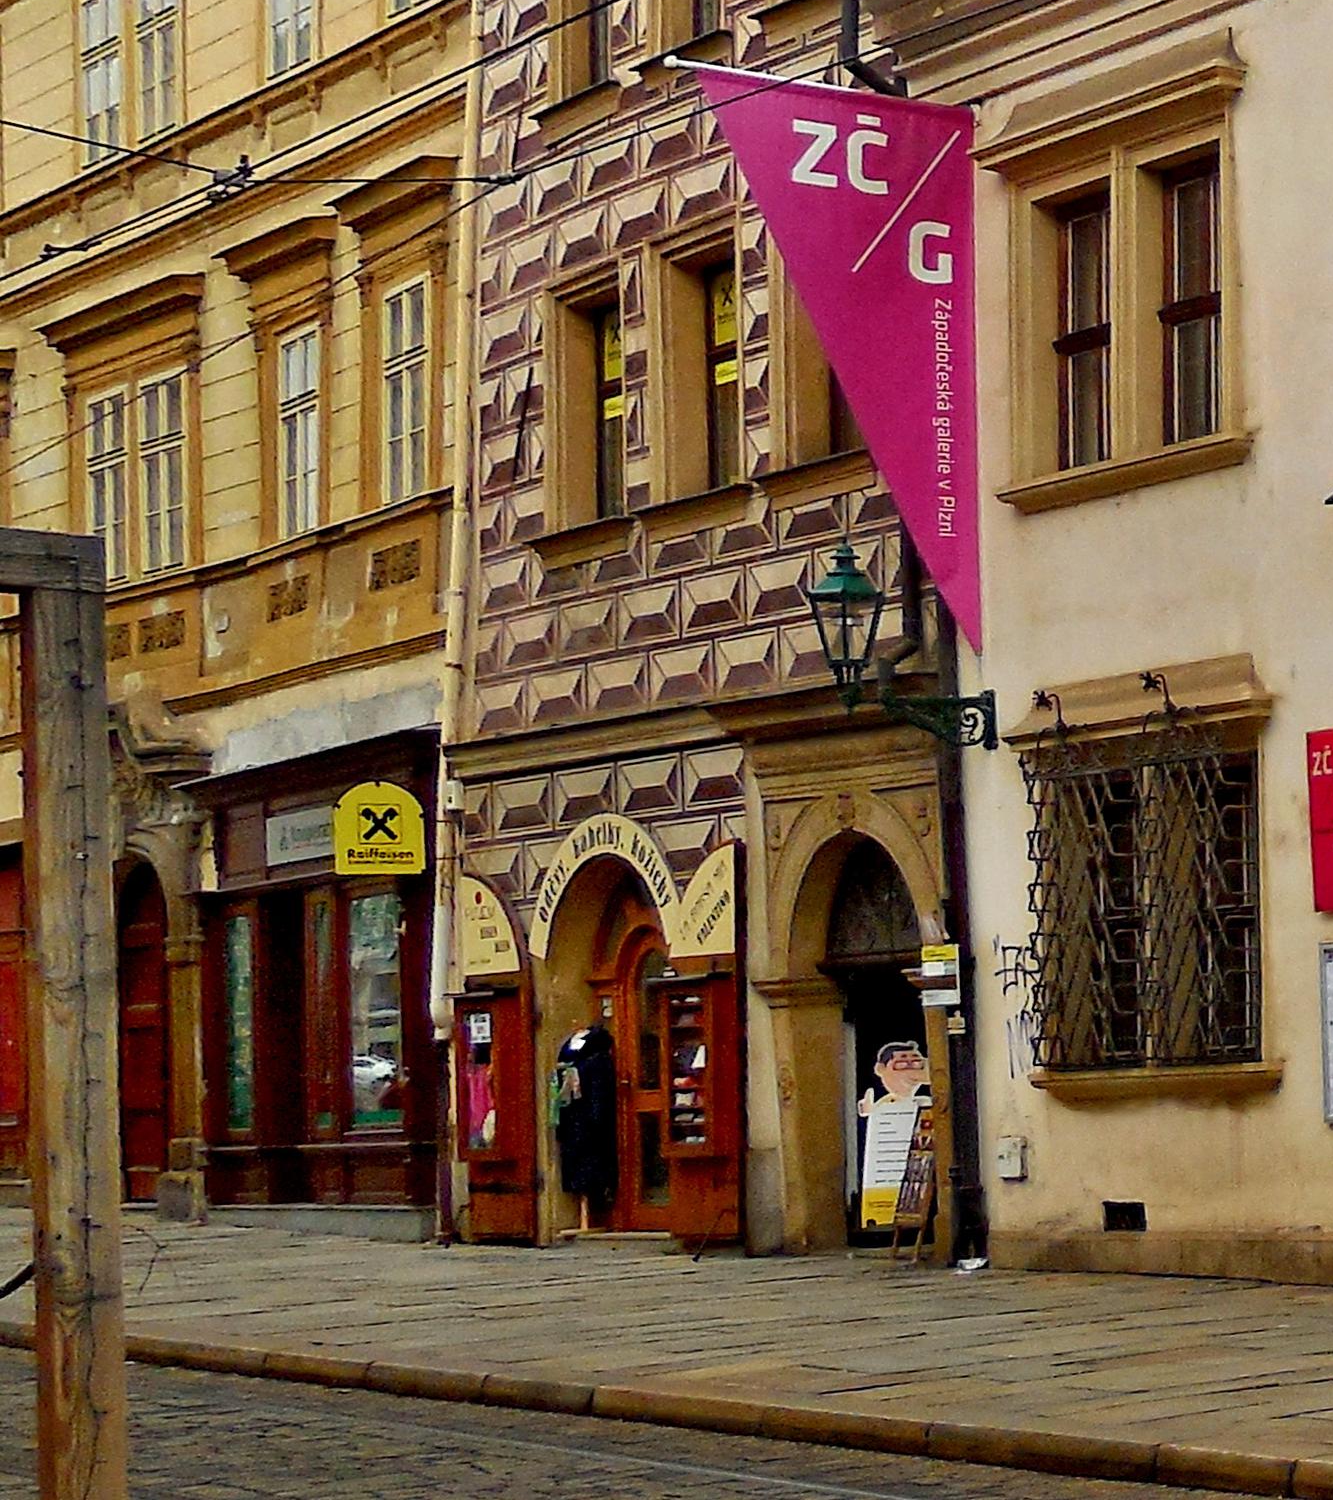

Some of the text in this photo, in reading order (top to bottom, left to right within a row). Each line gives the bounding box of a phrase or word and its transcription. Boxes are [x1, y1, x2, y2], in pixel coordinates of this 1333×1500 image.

[791, 114, 889, 195] ZČ
[908, 221, 953, 284] G
[931, 298, 954, 411] Západočeská
[932, 417, 955, 475] galerie
[938, 480, 951, 489] v
